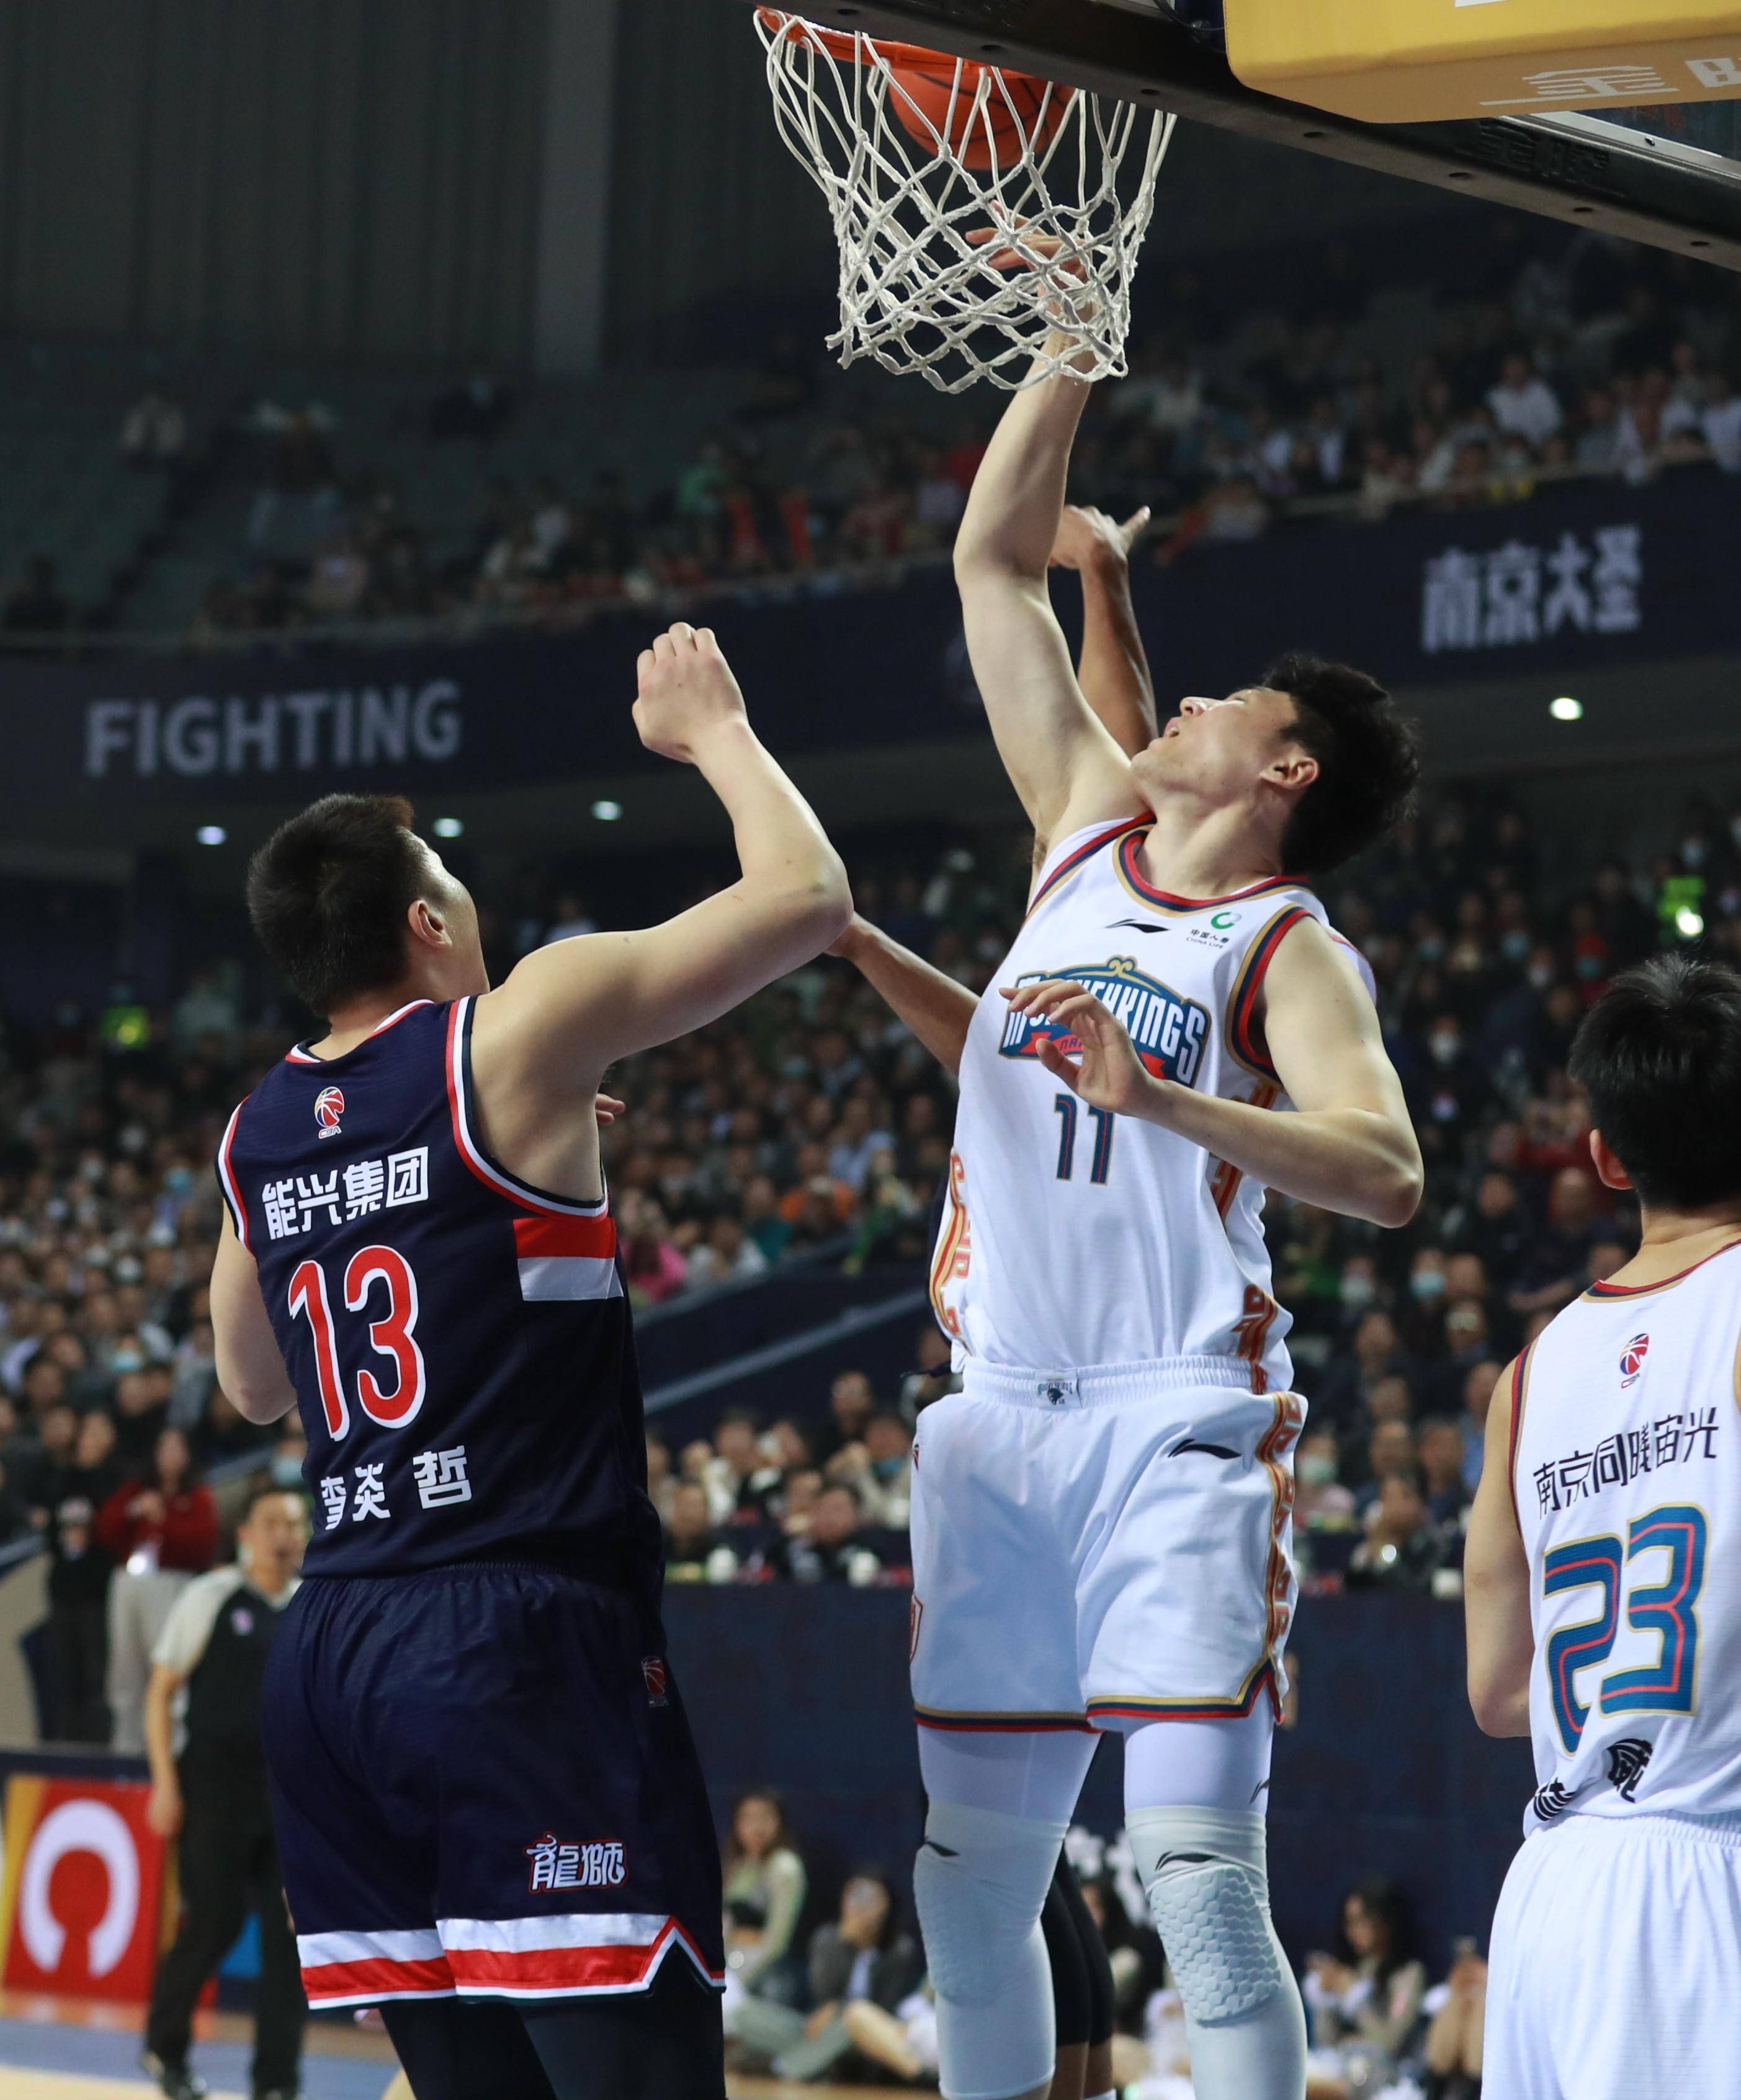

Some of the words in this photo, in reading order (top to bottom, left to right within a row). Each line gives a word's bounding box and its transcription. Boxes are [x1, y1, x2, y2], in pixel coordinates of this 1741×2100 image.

[86, 679, 461, 777] FIGHTING
[318, 1125, 342, 1139] CBA
[1054, 1092, 1116, 1186] 11
[262, 1146, 429, 1240] 能兴集团
[289, 1245, 426, 1442] 13
[1543, 1501, 1710, 1757] 23
